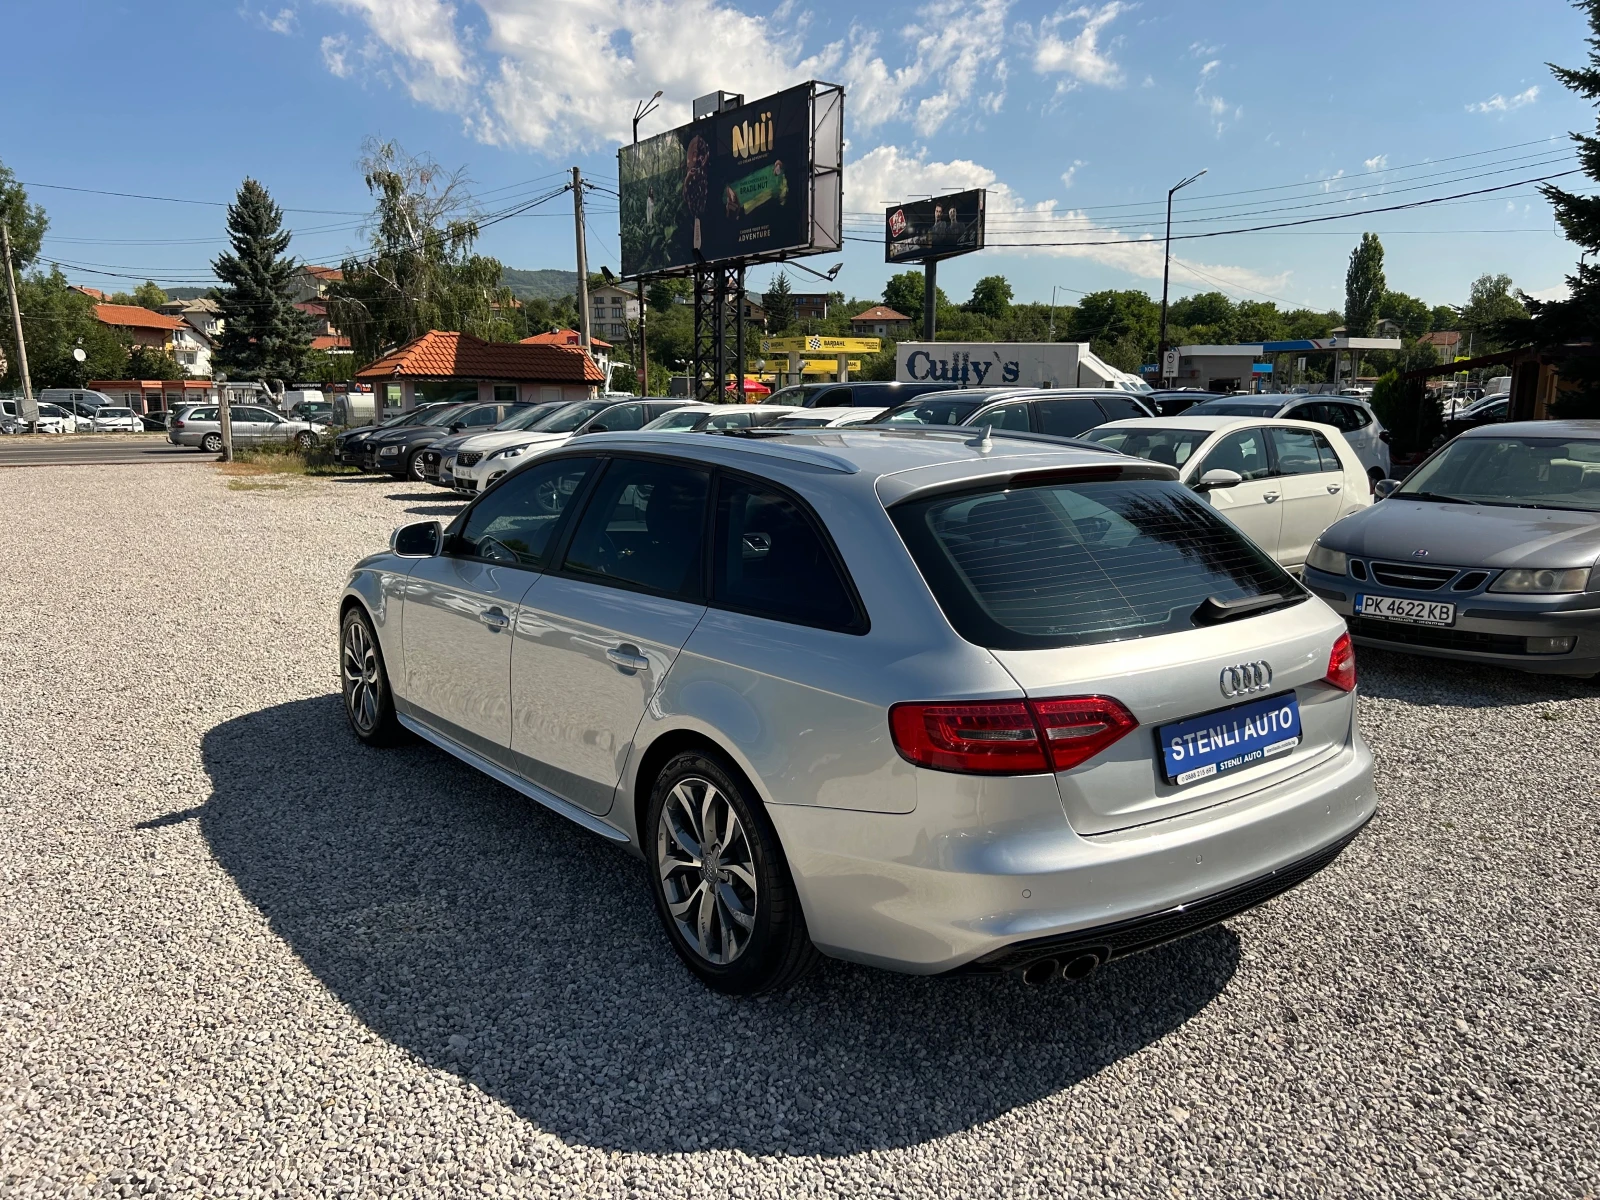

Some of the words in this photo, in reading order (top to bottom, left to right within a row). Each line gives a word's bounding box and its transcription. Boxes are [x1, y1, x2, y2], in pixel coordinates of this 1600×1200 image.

[732, 111, 774, 159] Nuii
[740, 184, 757, 195] BRAZIL
[757, 180, 768, 190] NUT
[738, 229, 771, 242] ADVENTURE
[1364, 597, 1384, 613] PK
[1386, 600, 1426, 618] 4622
[1428, 604, 1450, 620] KB
[1171, 721, 1240, 760] STENLI
[1244, 706, 1292, 740] AUTO
[1220, 756, 1242, 770] STENLI
[1244, 750, 1262, 763] AUTO
